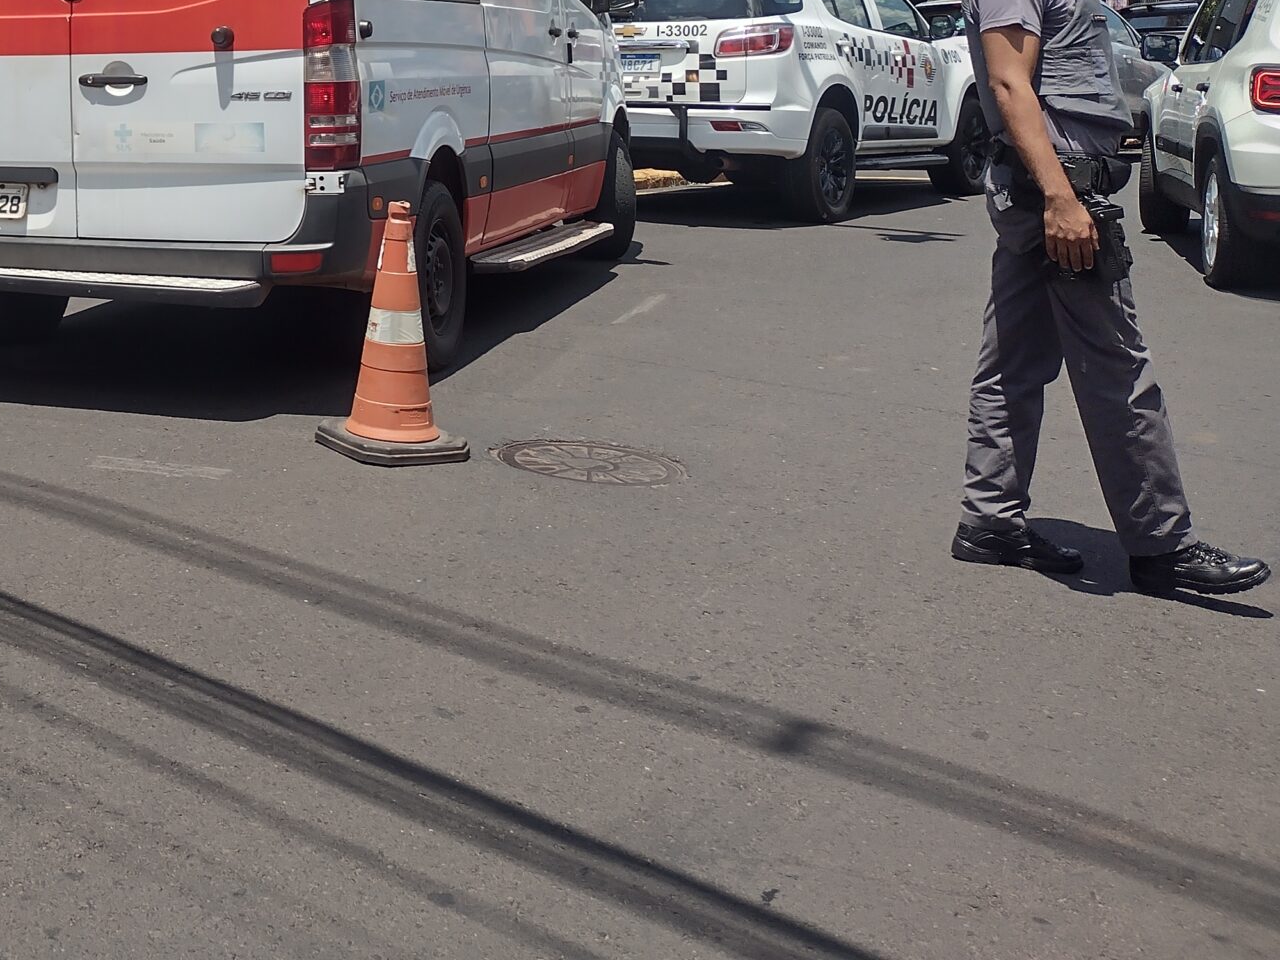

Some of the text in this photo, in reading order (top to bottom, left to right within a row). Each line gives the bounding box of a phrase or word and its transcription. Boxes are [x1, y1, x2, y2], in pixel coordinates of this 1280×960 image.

[656, 24, 708, 37] I-33002
[263, 91, 293, 102] CDI
[863, 92, 938, 127] POLÍCIA
